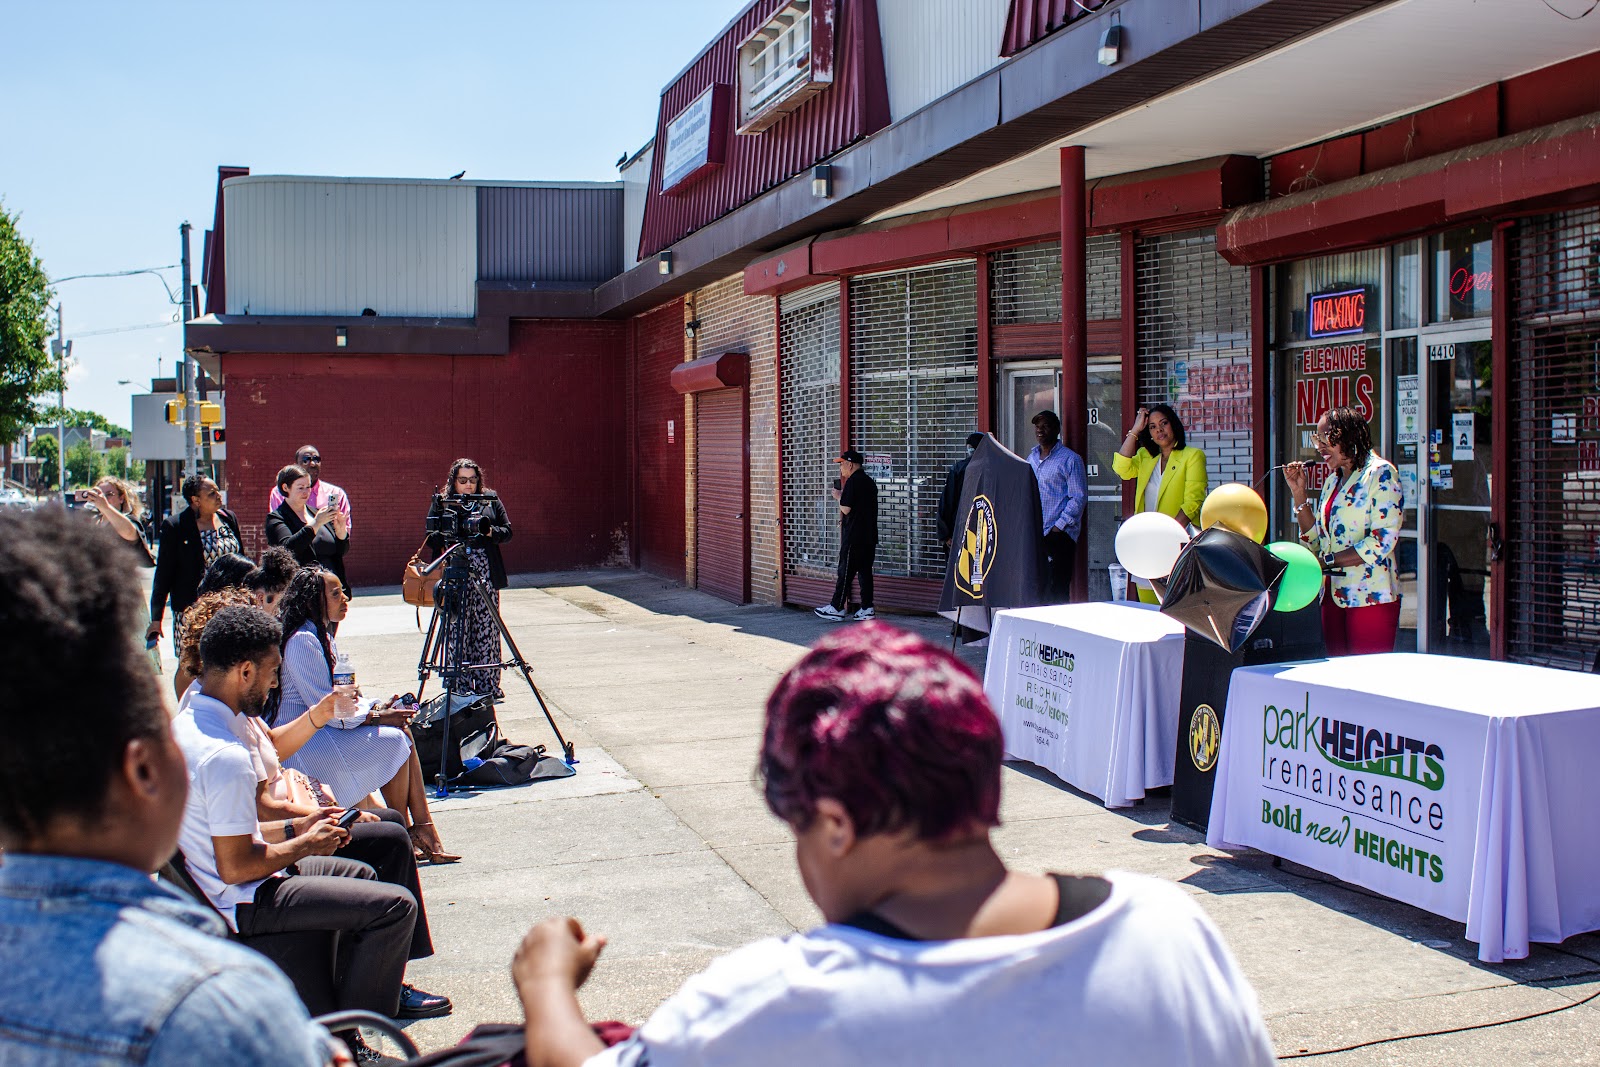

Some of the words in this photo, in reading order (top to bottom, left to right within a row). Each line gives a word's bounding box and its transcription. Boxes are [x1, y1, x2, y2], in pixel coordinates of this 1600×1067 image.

[1314, 293, 1365, 331] WAXING
[1303, 343, 1367, 374] ELEGANCE
[1431, 344, 1454, 359] 4410
[1176, 398, 1252, 432] OPENIN
[1296, 374, 1373, 426] NAILS
[1402, 406, 1416, 414] POLICE
[1399, 433, 1418, 441] ENFORCE
[1018, 632, 1040, 669] park
[1039, 643, 1075, 672] HEIGHTS
[1016, 694, 1034, 709] Bold
[1262, 691, 1320, 778] park
[1320, 716, 1445, 792] HEIGHTS
[1269, 756, 1444, 831] renaissance
[1261, 799, 1302, 834] Bold
[1306, 815, 1352, 849] new
[1354, 827, 1444, 883] HEIGHTS
